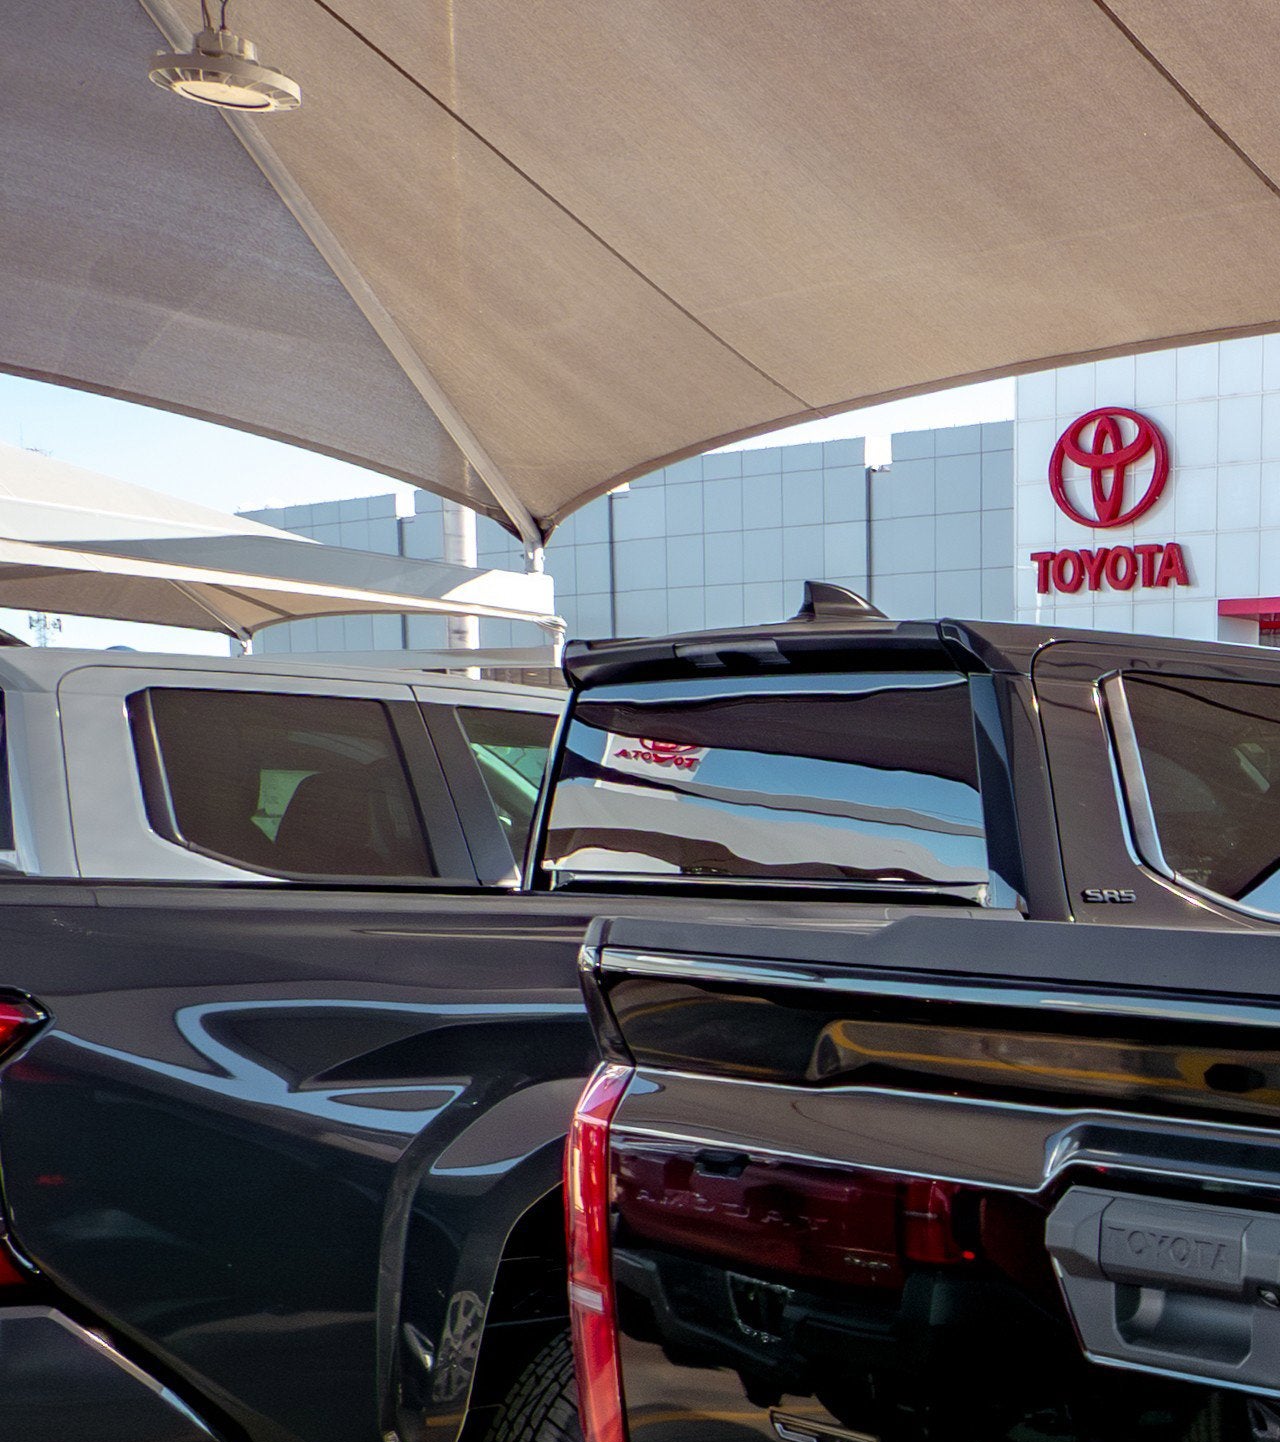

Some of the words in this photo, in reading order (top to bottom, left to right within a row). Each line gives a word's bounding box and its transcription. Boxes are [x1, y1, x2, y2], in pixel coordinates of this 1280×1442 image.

[1030, 542, 1189, 594] TOYOTA
[1082, 888, 1137, 903] SR5
[1106, 1226, 1230, 1272] TOYOTA
